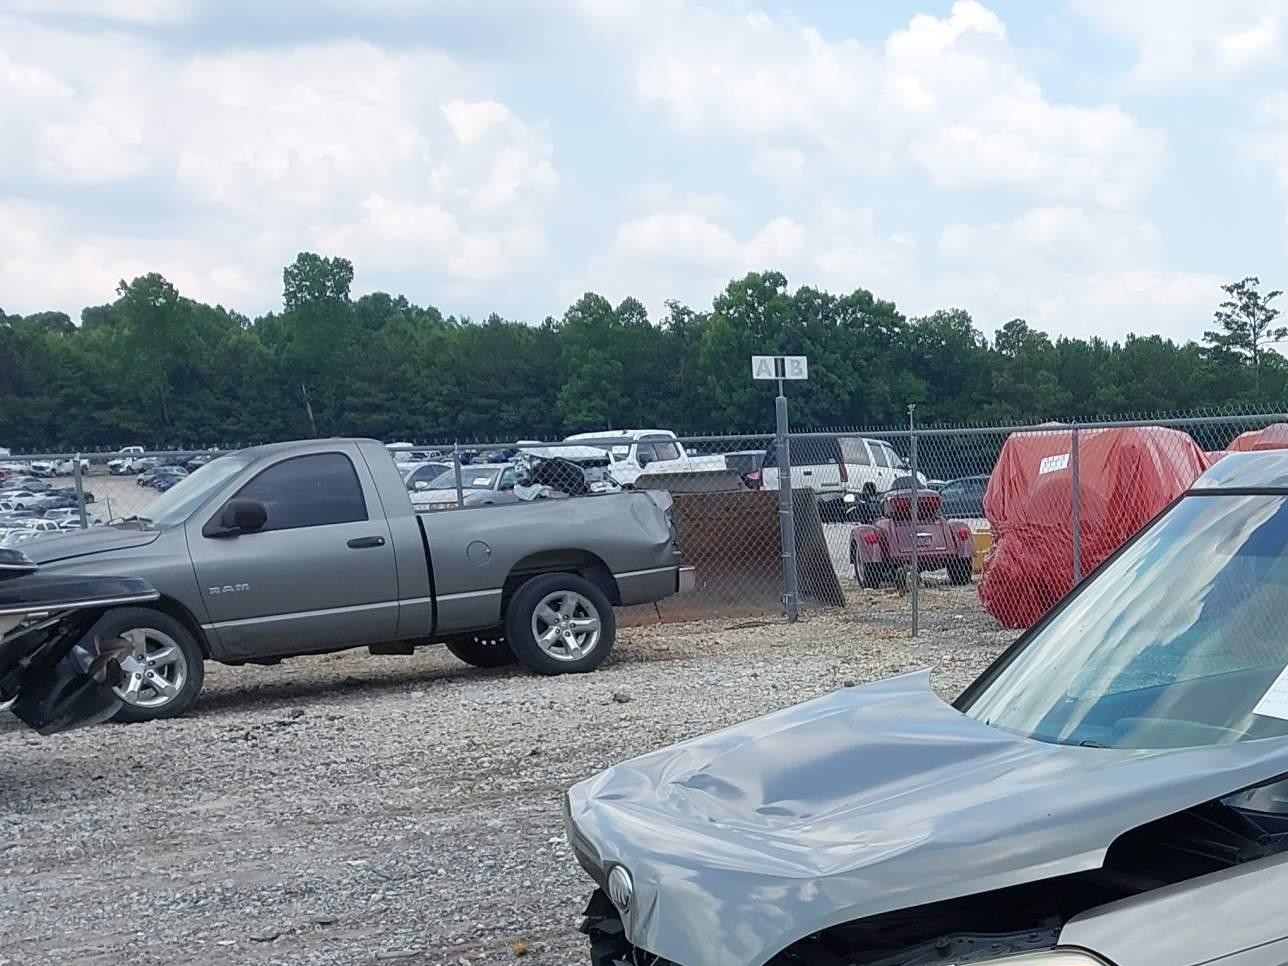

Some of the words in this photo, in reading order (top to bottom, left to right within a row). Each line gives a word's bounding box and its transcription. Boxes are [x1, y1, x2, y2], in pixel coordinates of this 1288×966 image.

[756, 359, 773, 376] A
[790, 359, 803, 377] B
[208, 583, 250, 594] RAM
